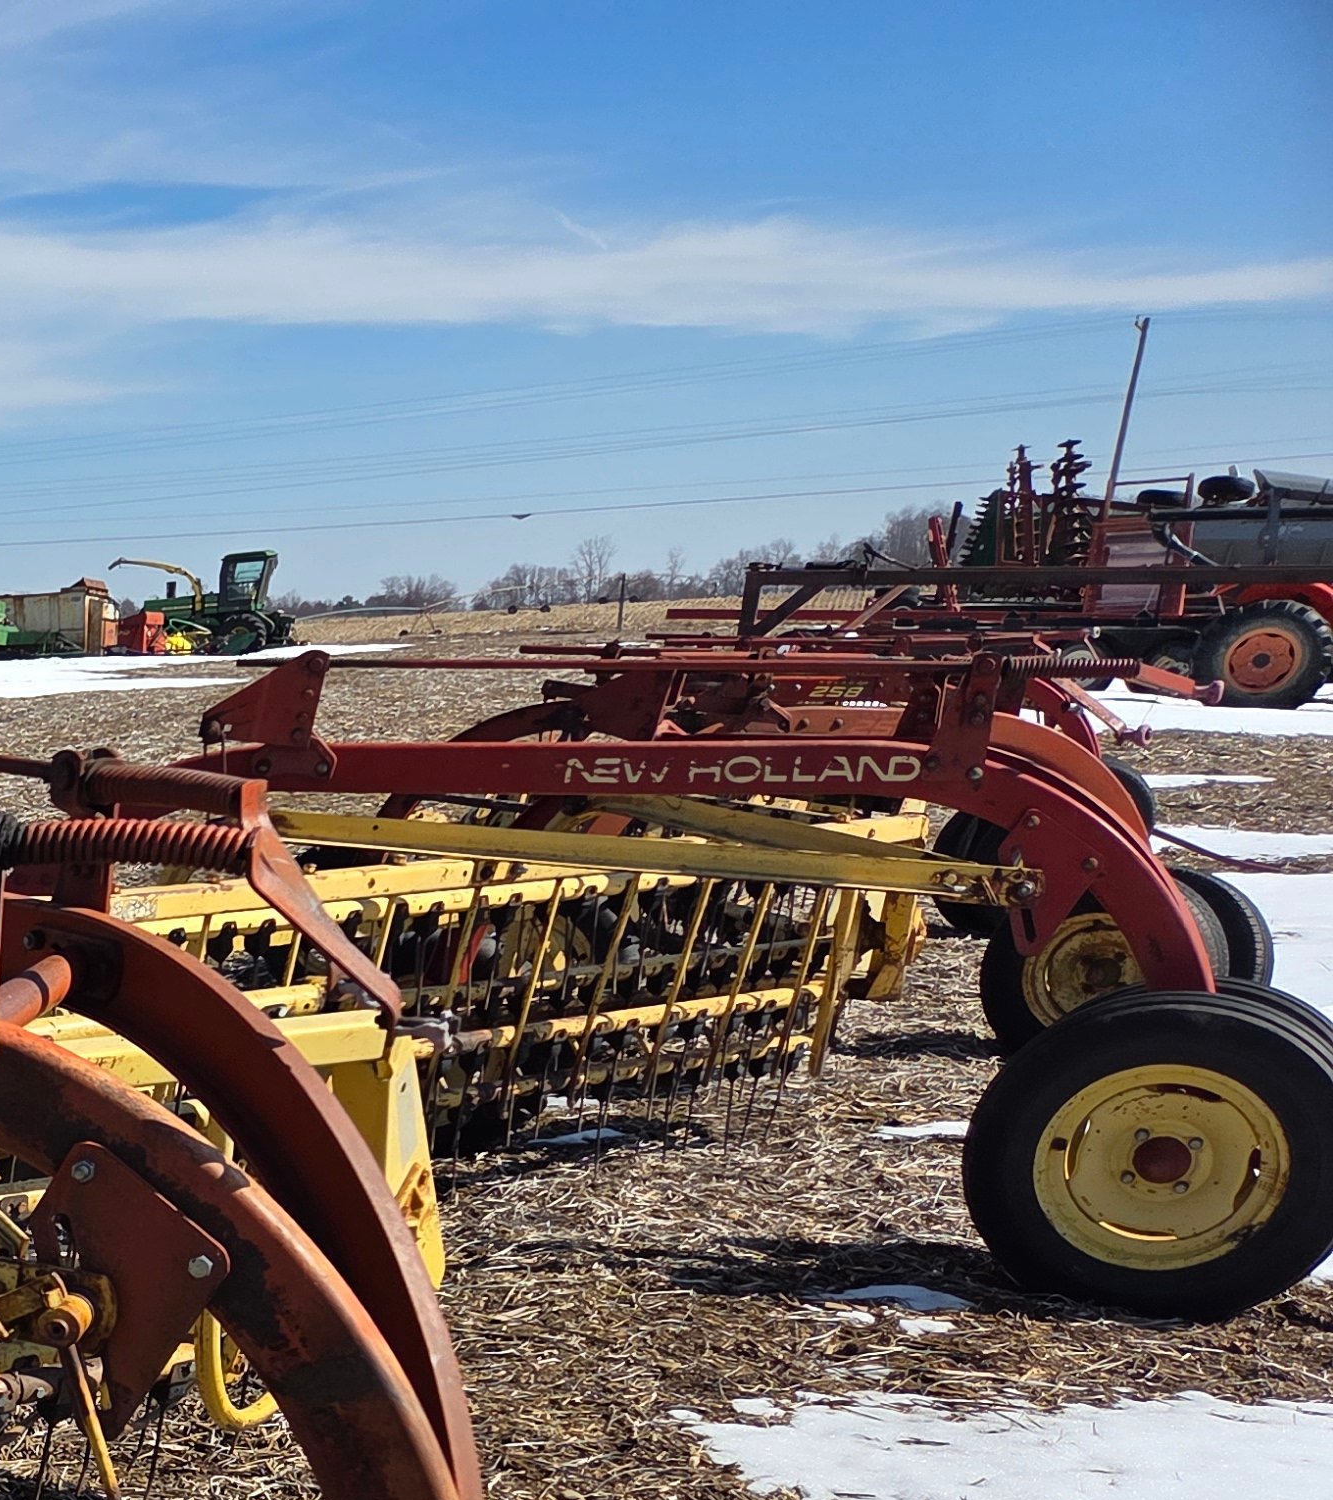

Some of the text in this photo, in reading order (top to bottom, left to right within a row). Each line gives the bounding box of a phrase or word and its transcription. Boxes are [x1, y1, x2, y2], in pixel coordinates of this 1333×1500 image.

[809, 685, 864, 698] 258
[564, 756, 921, 784] NEW HOLLAND
